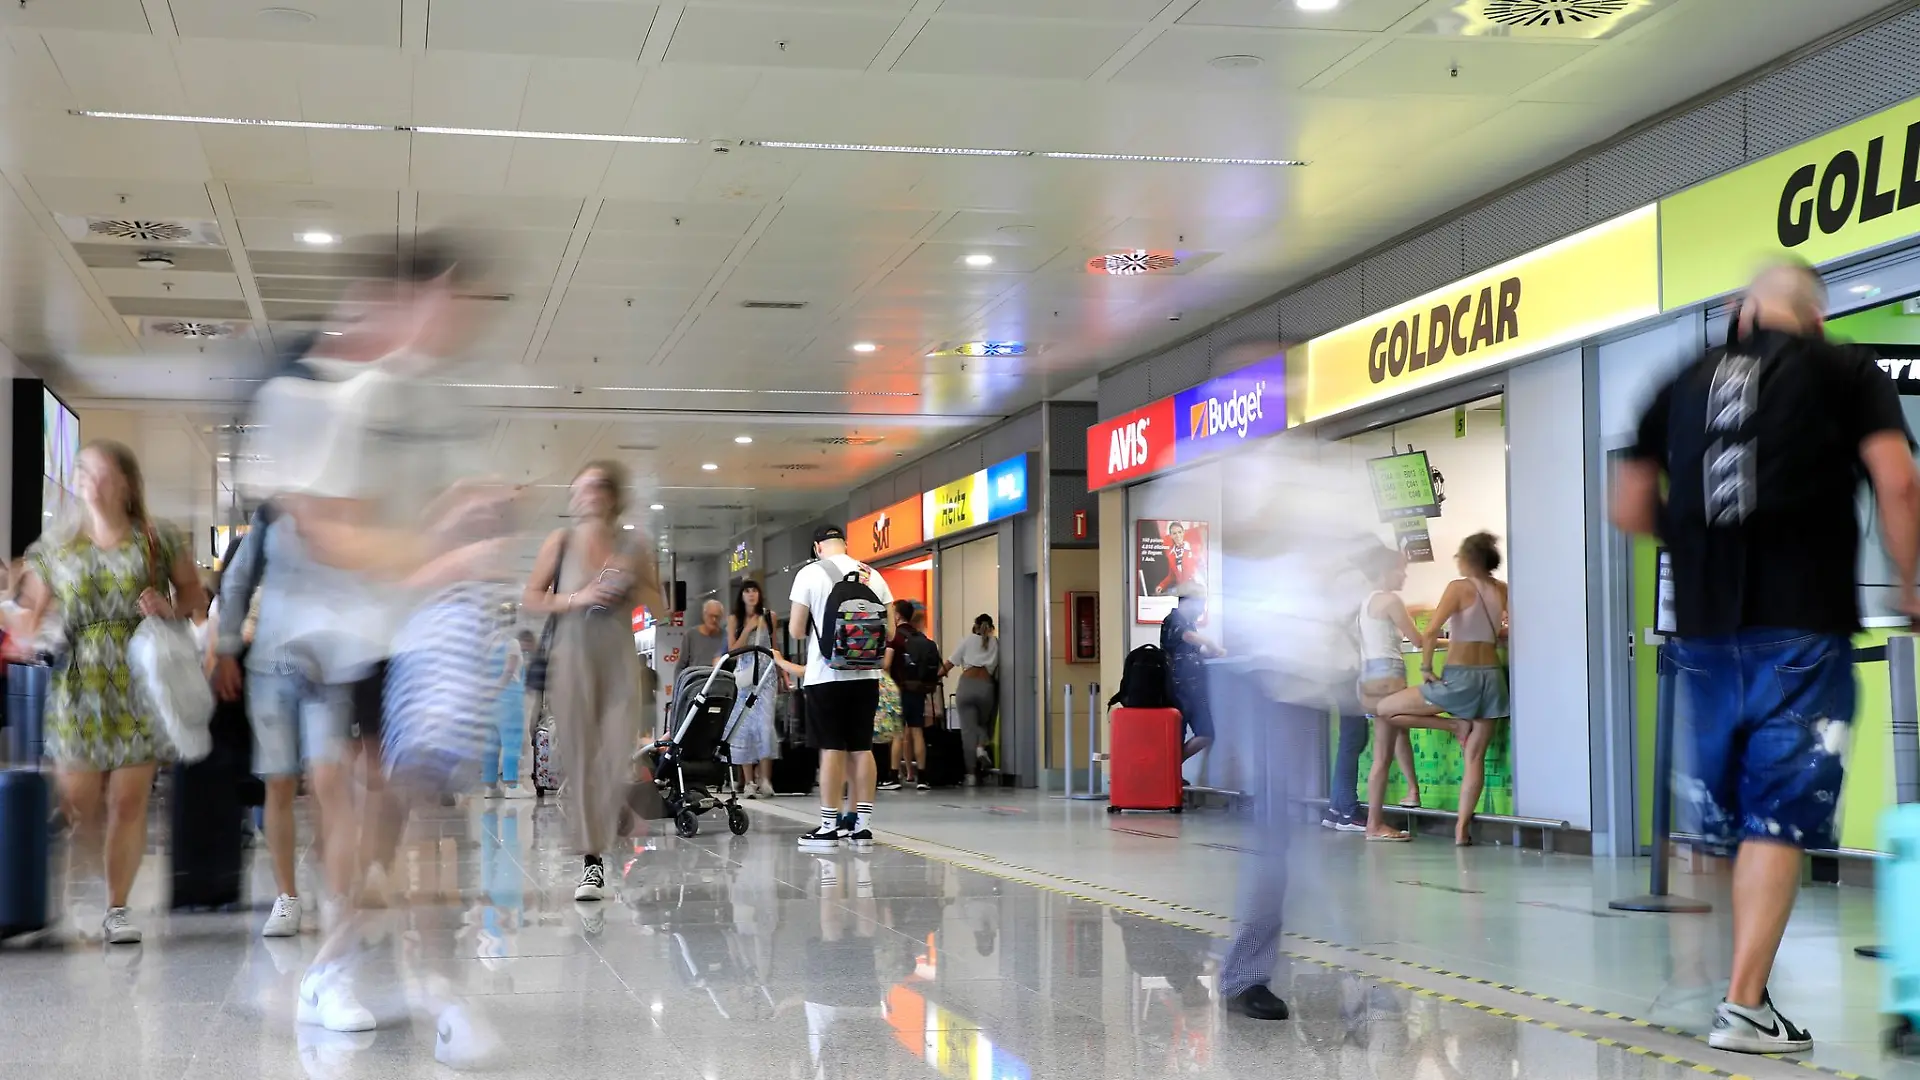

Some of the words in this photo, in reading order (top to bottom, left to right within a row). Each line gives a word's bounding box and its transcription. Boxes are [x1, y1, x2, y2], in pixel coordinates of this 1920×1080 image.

[1369, 276, 1521, 384] GOLDCAR
[1208, 382, 1263, 438] Budget
[1458, 418, 1464, 432] 5
[1108, 418, 1149, 474] AVIS
[941, 490, 966, 527] Hertz
